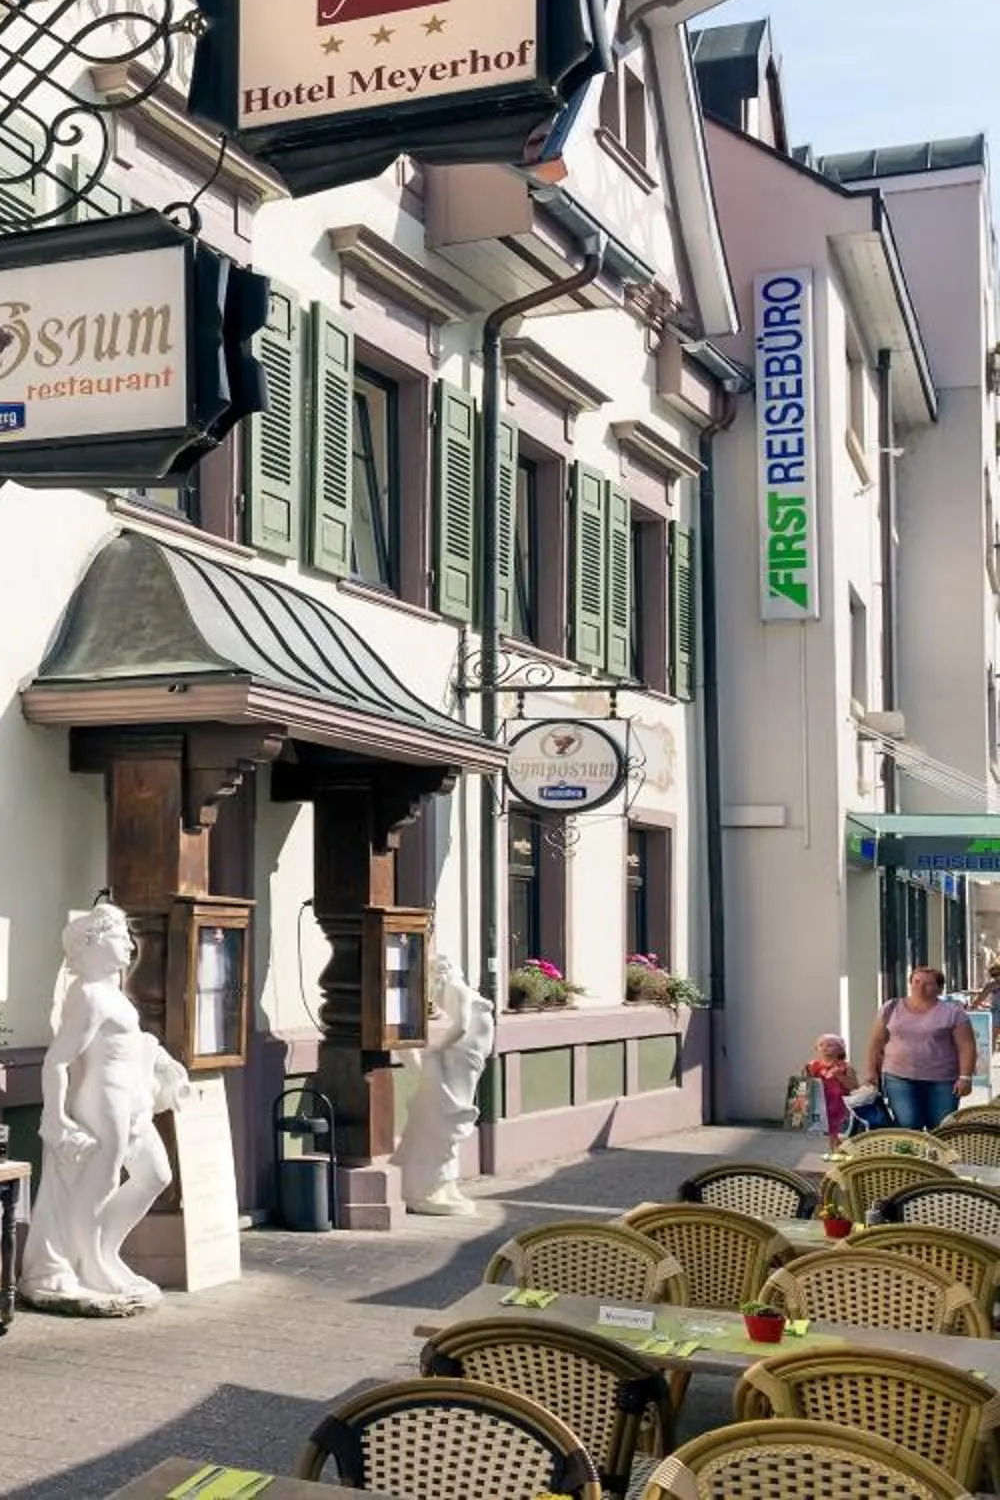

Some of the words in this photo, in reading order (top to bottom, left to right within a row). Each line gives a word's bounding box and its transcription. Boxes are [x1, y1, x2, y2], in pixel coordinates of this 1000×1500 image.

[241, 75, 336, 115] Hotel
[347, 39, 535, 97] Meyerhof
[26, 367, 174, 401] restaurant
[757, 276, 805, 485] REISEBÜRO
[767, 491, 809, 610] FIRST
